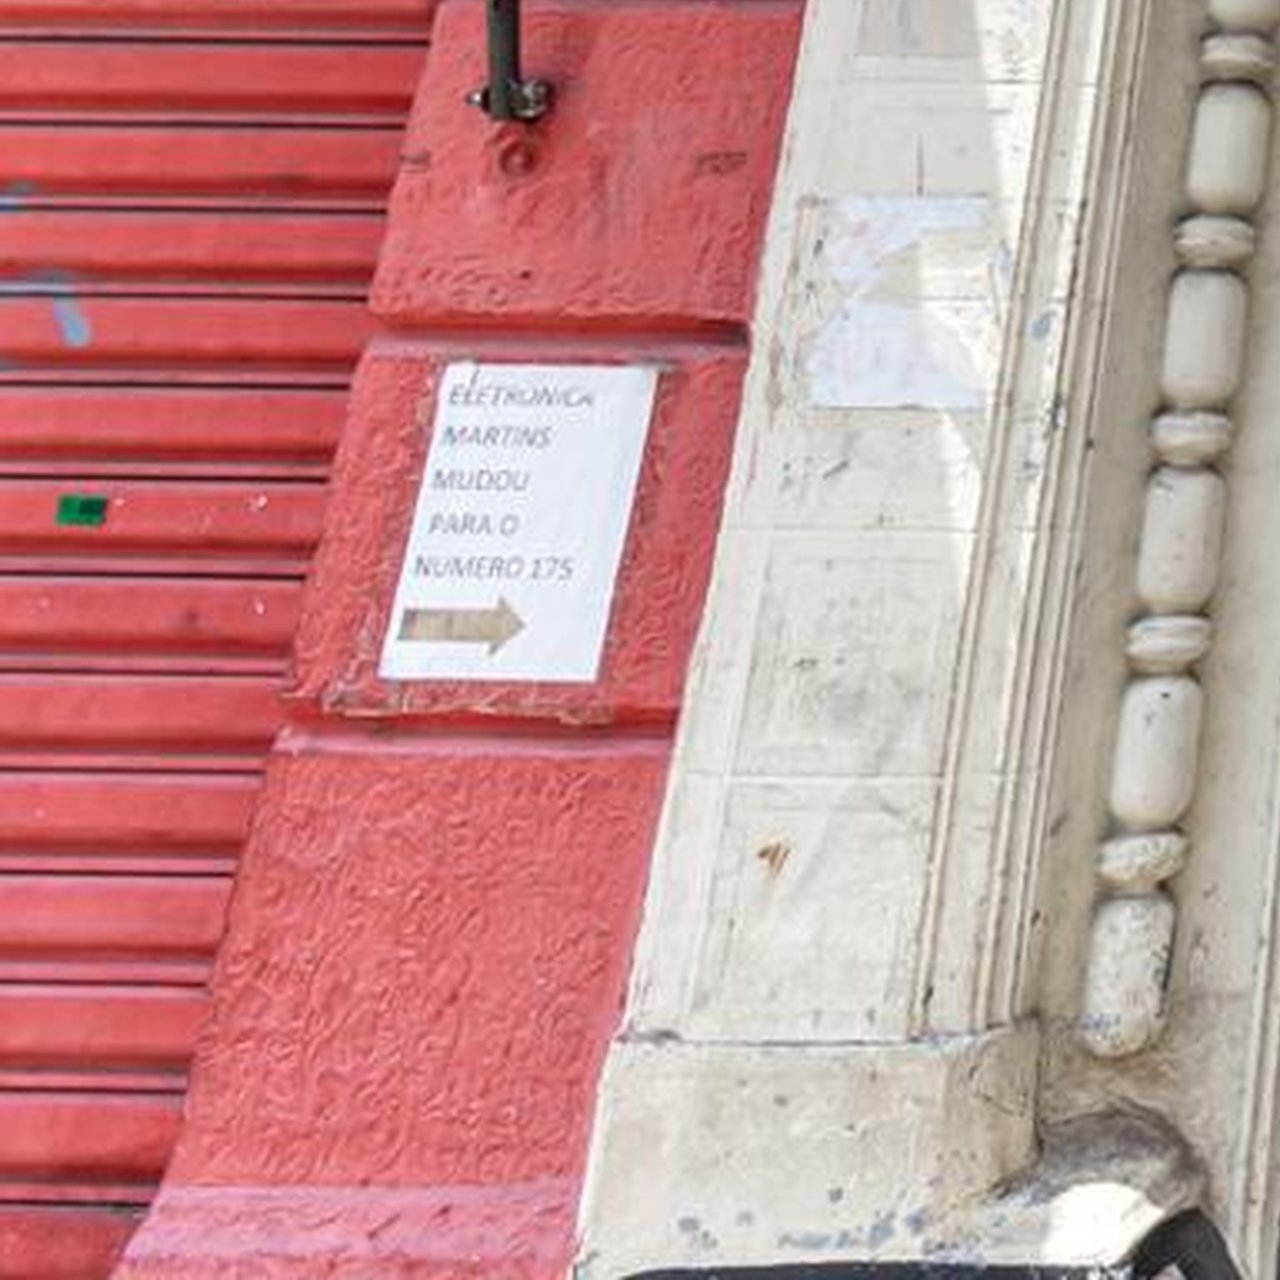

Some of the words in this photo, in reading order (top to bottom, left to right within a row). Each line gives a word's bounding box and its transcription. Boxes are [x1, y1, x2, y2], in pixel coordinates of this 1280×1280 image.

[449, 382, 596, 407] ELETRONICA
[442, 425, 553, 448] MARTINS
[432, 468, 531, 491] MUDOU
[428, 513, 492, 535] PARA
[499, 513, 520, 536] O
[414, 555, 526, 579] NUMERO
[530, 557, 575, 581] 175
